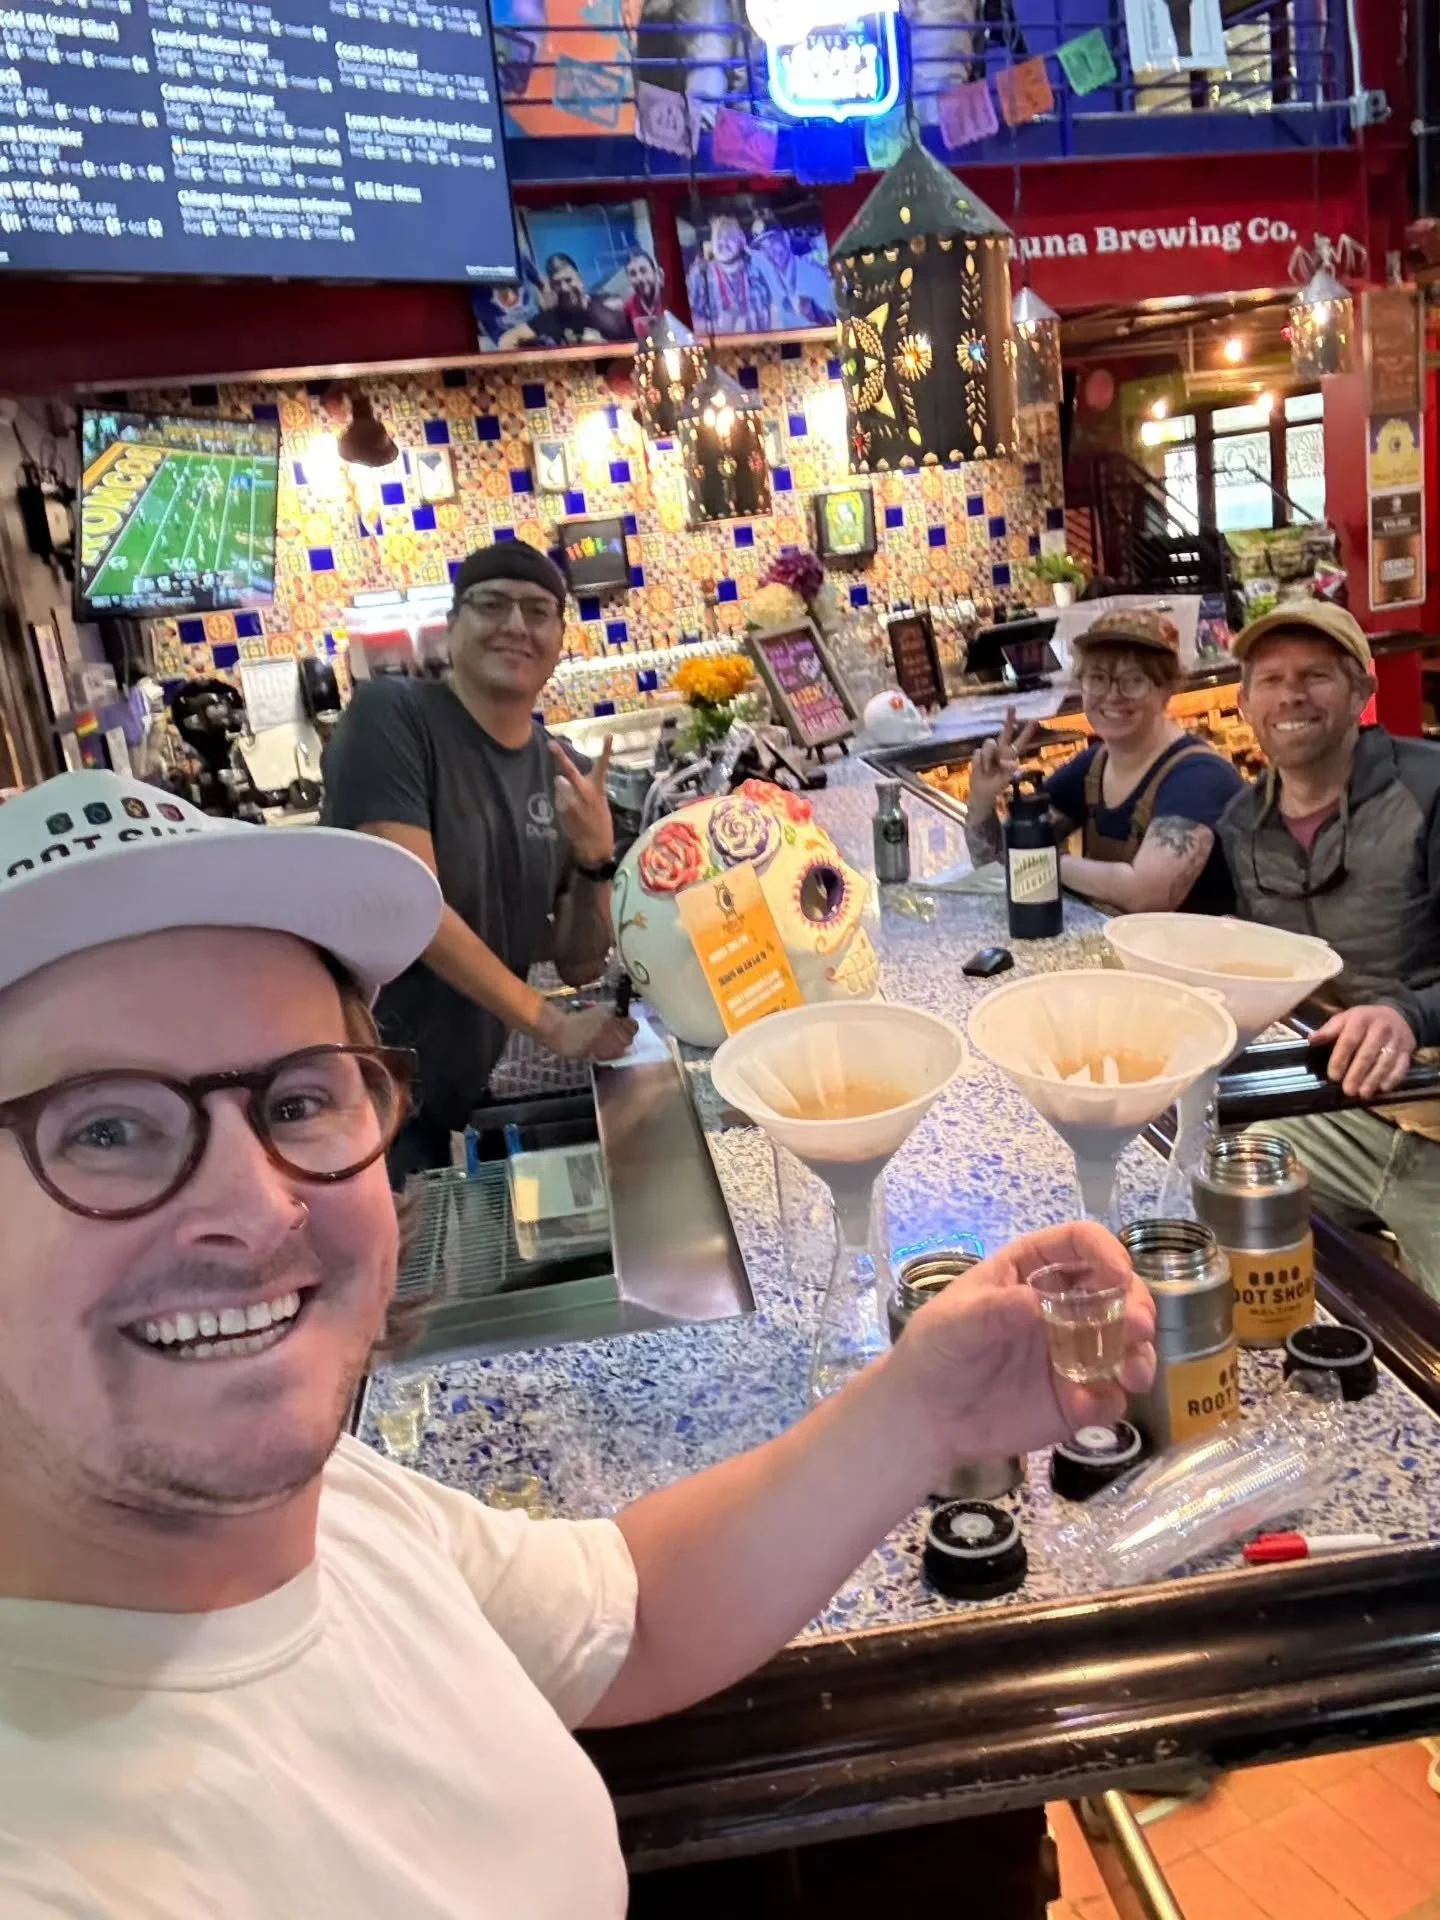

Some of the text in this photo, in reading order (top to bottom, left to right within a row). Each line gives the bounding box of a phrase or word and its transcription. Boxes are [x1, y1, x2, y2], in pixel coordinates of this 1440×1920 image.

[1094, 216, 1242, 252] Brewing
[1247, 217, 1297, 243] Co.
[1187, 1387, 1233, 1417] ROOT
